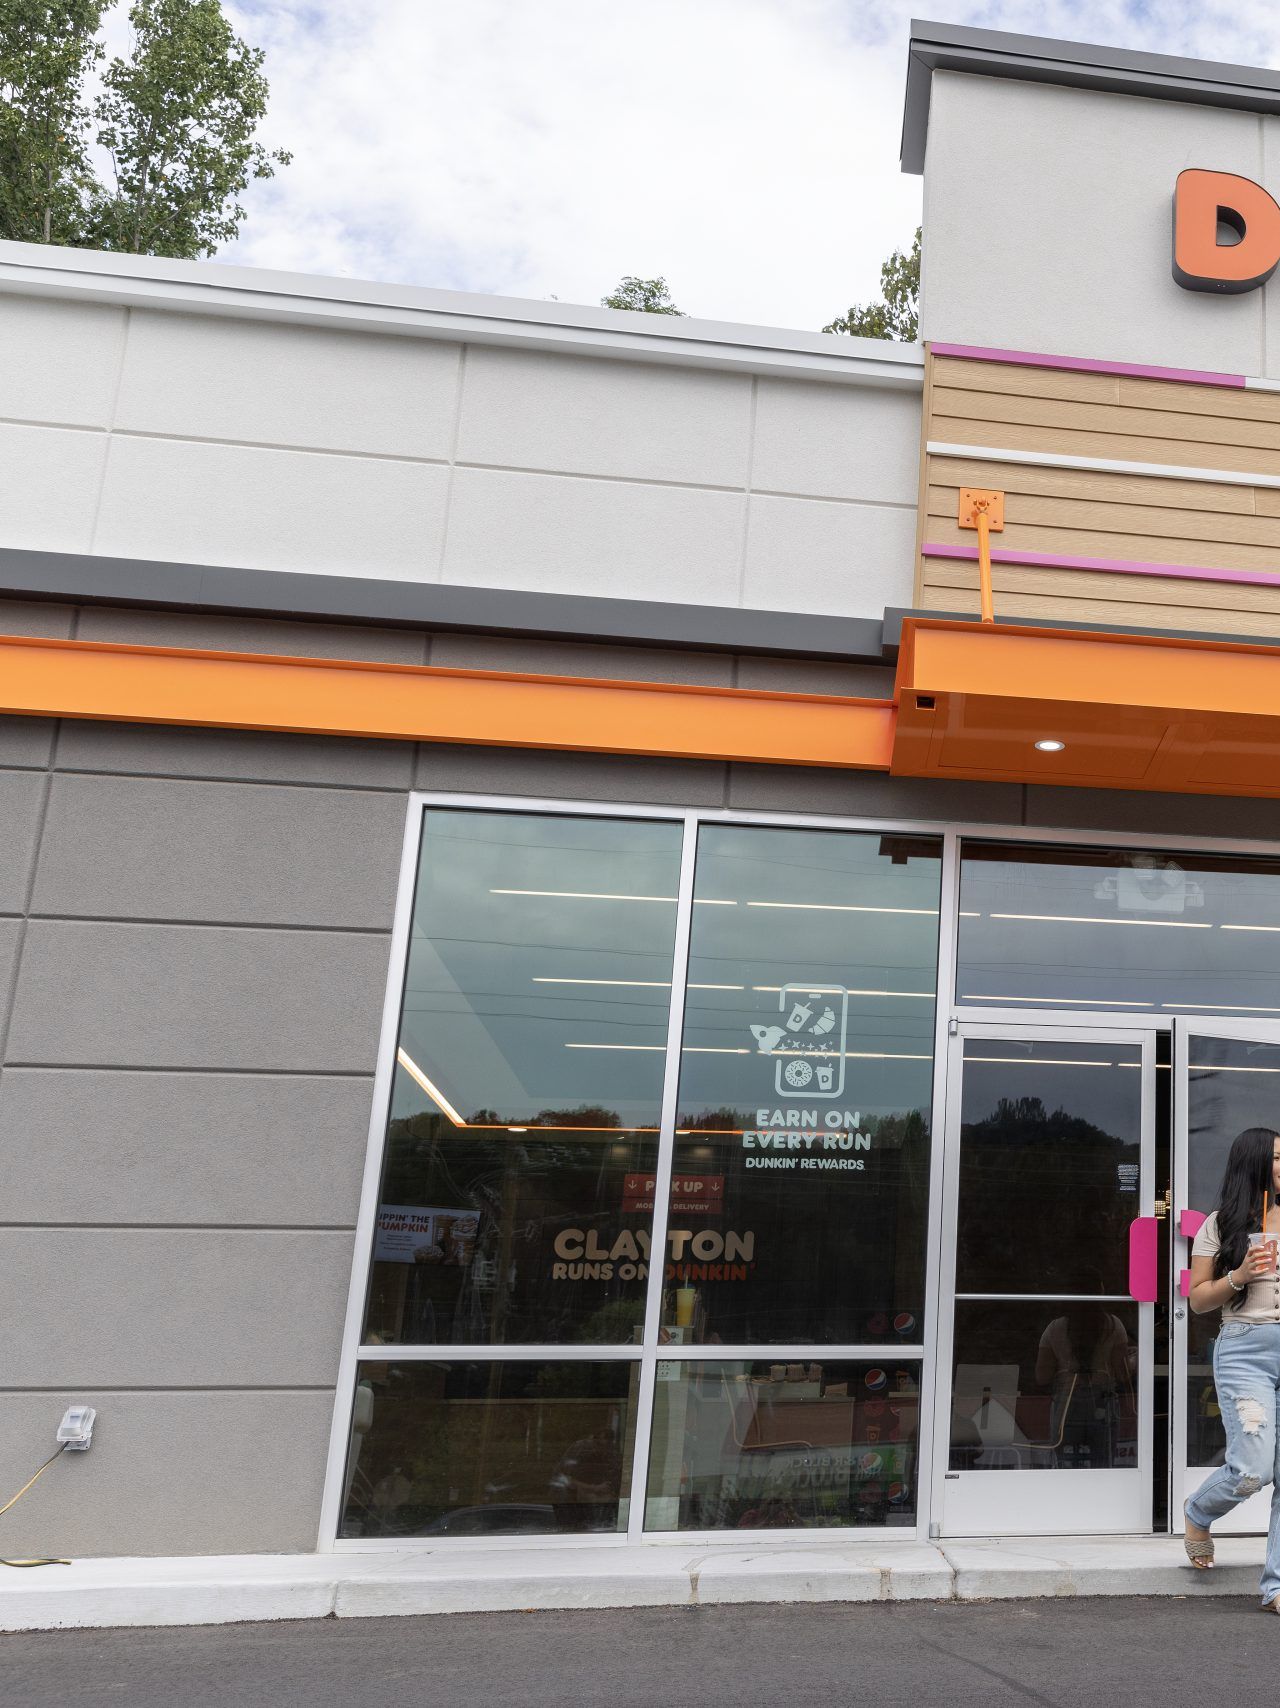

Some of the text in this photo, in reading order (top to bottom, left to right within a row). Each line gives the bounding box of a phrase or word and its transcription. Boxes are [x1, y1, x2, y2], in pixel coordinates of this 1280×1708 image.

[756, 1109, 860, 1129] EARN ON
[742, 1131, 871, 1151] EVERY RUN
[745, 1157, 865, 1170] DUNKIN' REWARDS
[645, 1181, 704, 1193] PK UP
[379, 1213, 431, 1223] IPPIN' THE
[553, 1228, 754, 1262] CLAYTON
[553, 1263, 613, 1280] RUNS
